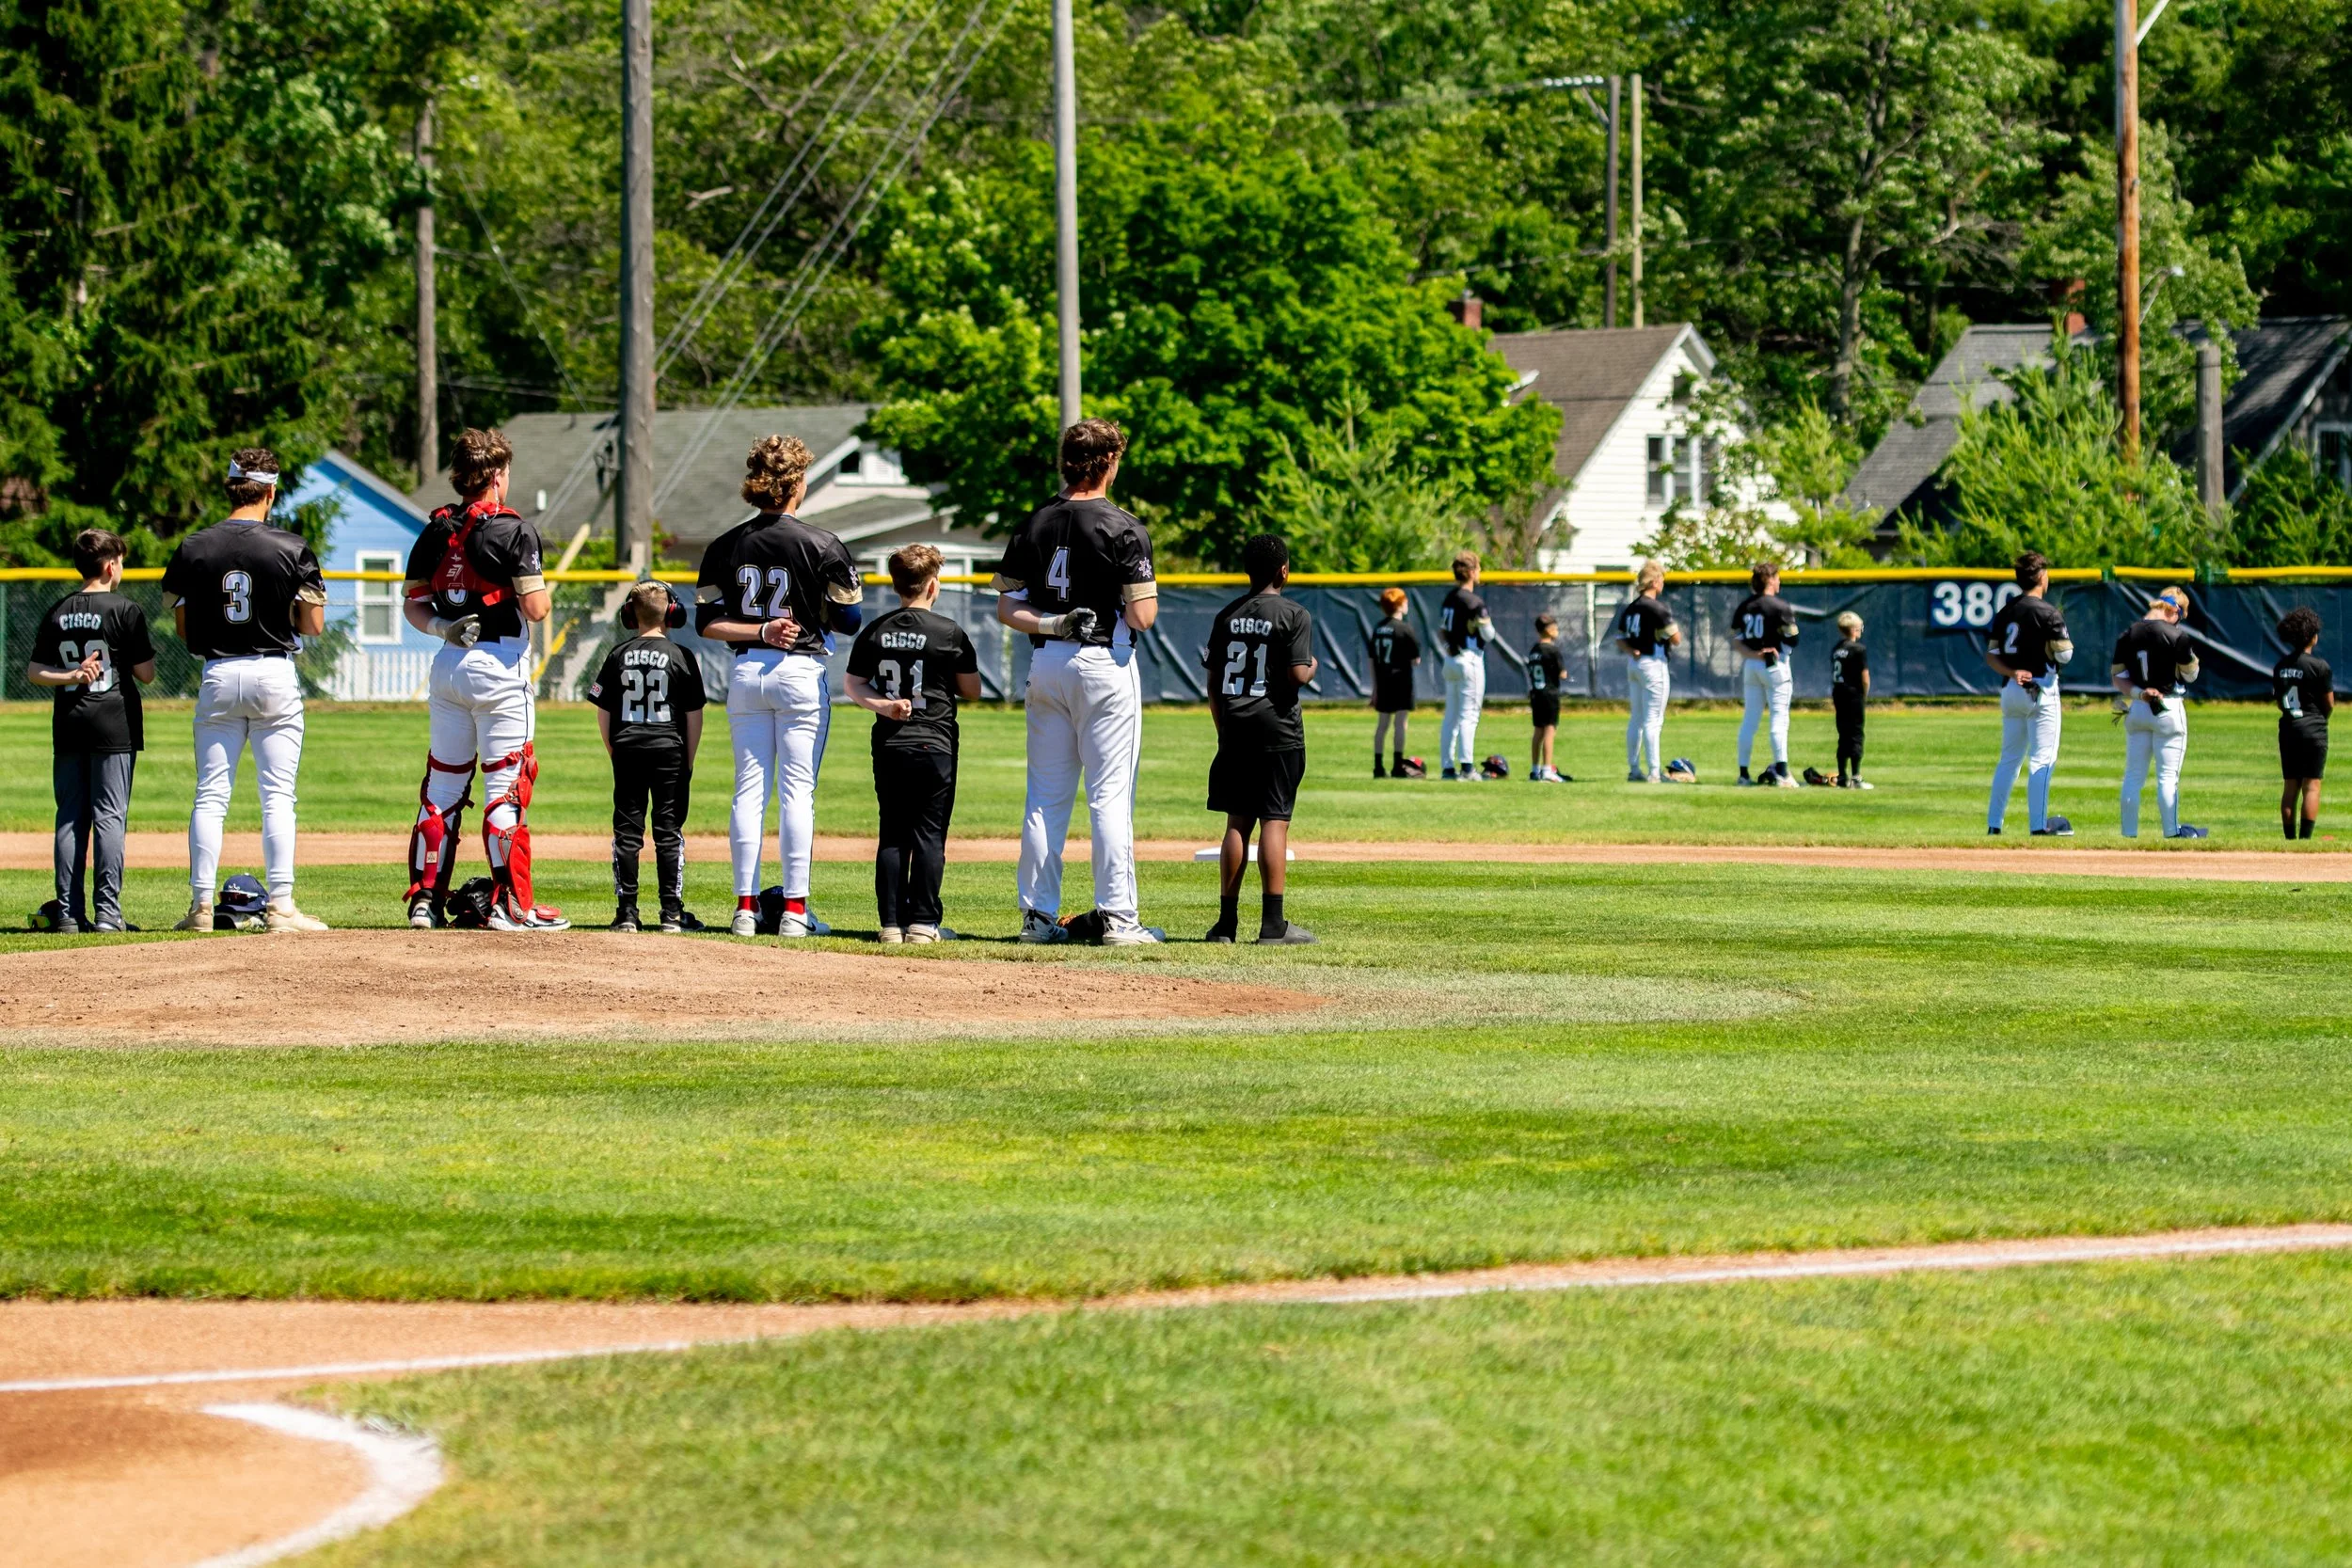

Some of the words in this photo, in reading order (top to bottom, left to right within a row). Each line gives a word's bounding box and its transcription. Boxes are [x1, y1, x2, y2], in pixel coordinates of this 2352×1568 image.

[1046, 546, 1072, 602] 4
[223, 570, 252, 624] 3
[737, 564, 792, 619] 22
[58, 612, 102, 631] CISCO
[1231, 618, 1273, 636] CISCO
[1742, 613, 1764, 639] 20
[2004, 622, 2019, 654] 2
[881, 632, 927, 650] CISCO
[1375, 639, 1392, 664] 17
[624, 650, 669, 669] CISCO
[1222, 641, 1267, 696] 21
[2137, 649, 2149, 682] 1
[621, 669, 672, 722] 22
[878, 659, 927, 709] 31
[2282, 686, 2303, 719] 4
